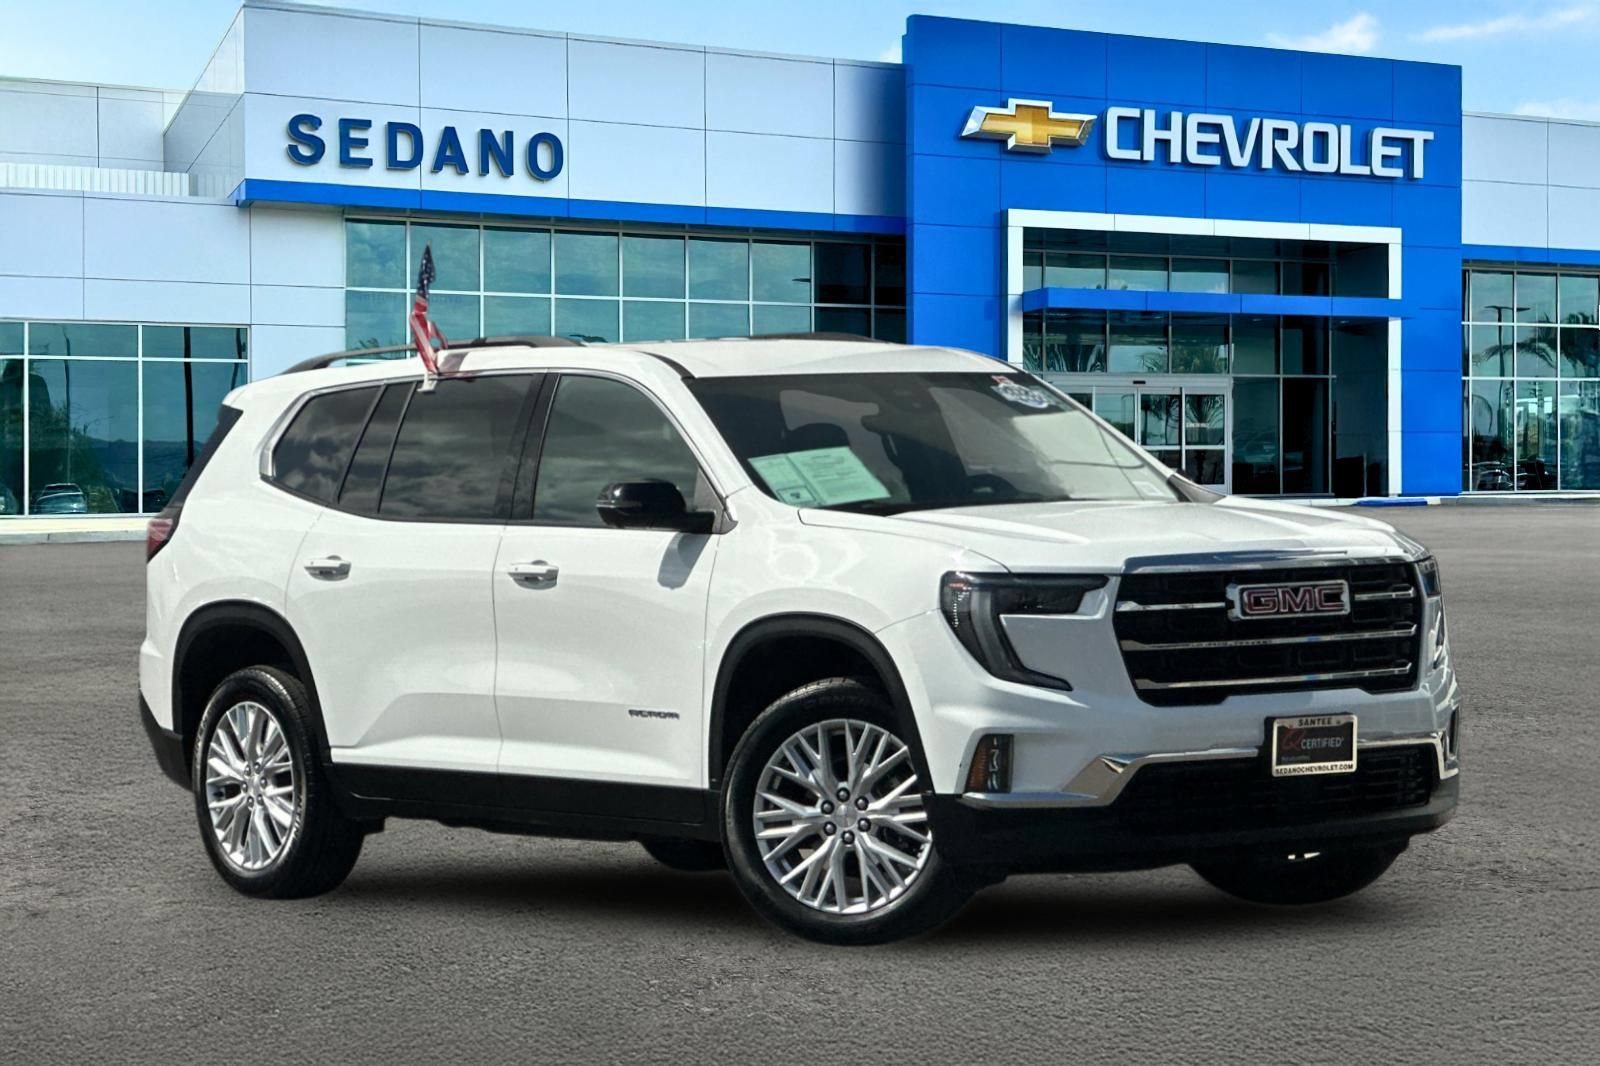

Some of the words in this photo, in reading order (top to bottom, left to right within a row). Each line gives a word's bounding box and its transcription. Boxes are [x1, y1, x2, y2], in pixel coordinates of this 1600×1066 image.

[287, 113, 564, 181] SEDANO
[1106, 106, 1435, 179] CHEVROLET
[1243, 585, 1345, 614] GMC
[1299, 717, 1332, 727] SANTEE
[1300, 737, 1343, 750] CERTIFIED
[1275, 763, 1354, 775] SEDANOCHEVROLET.COM
